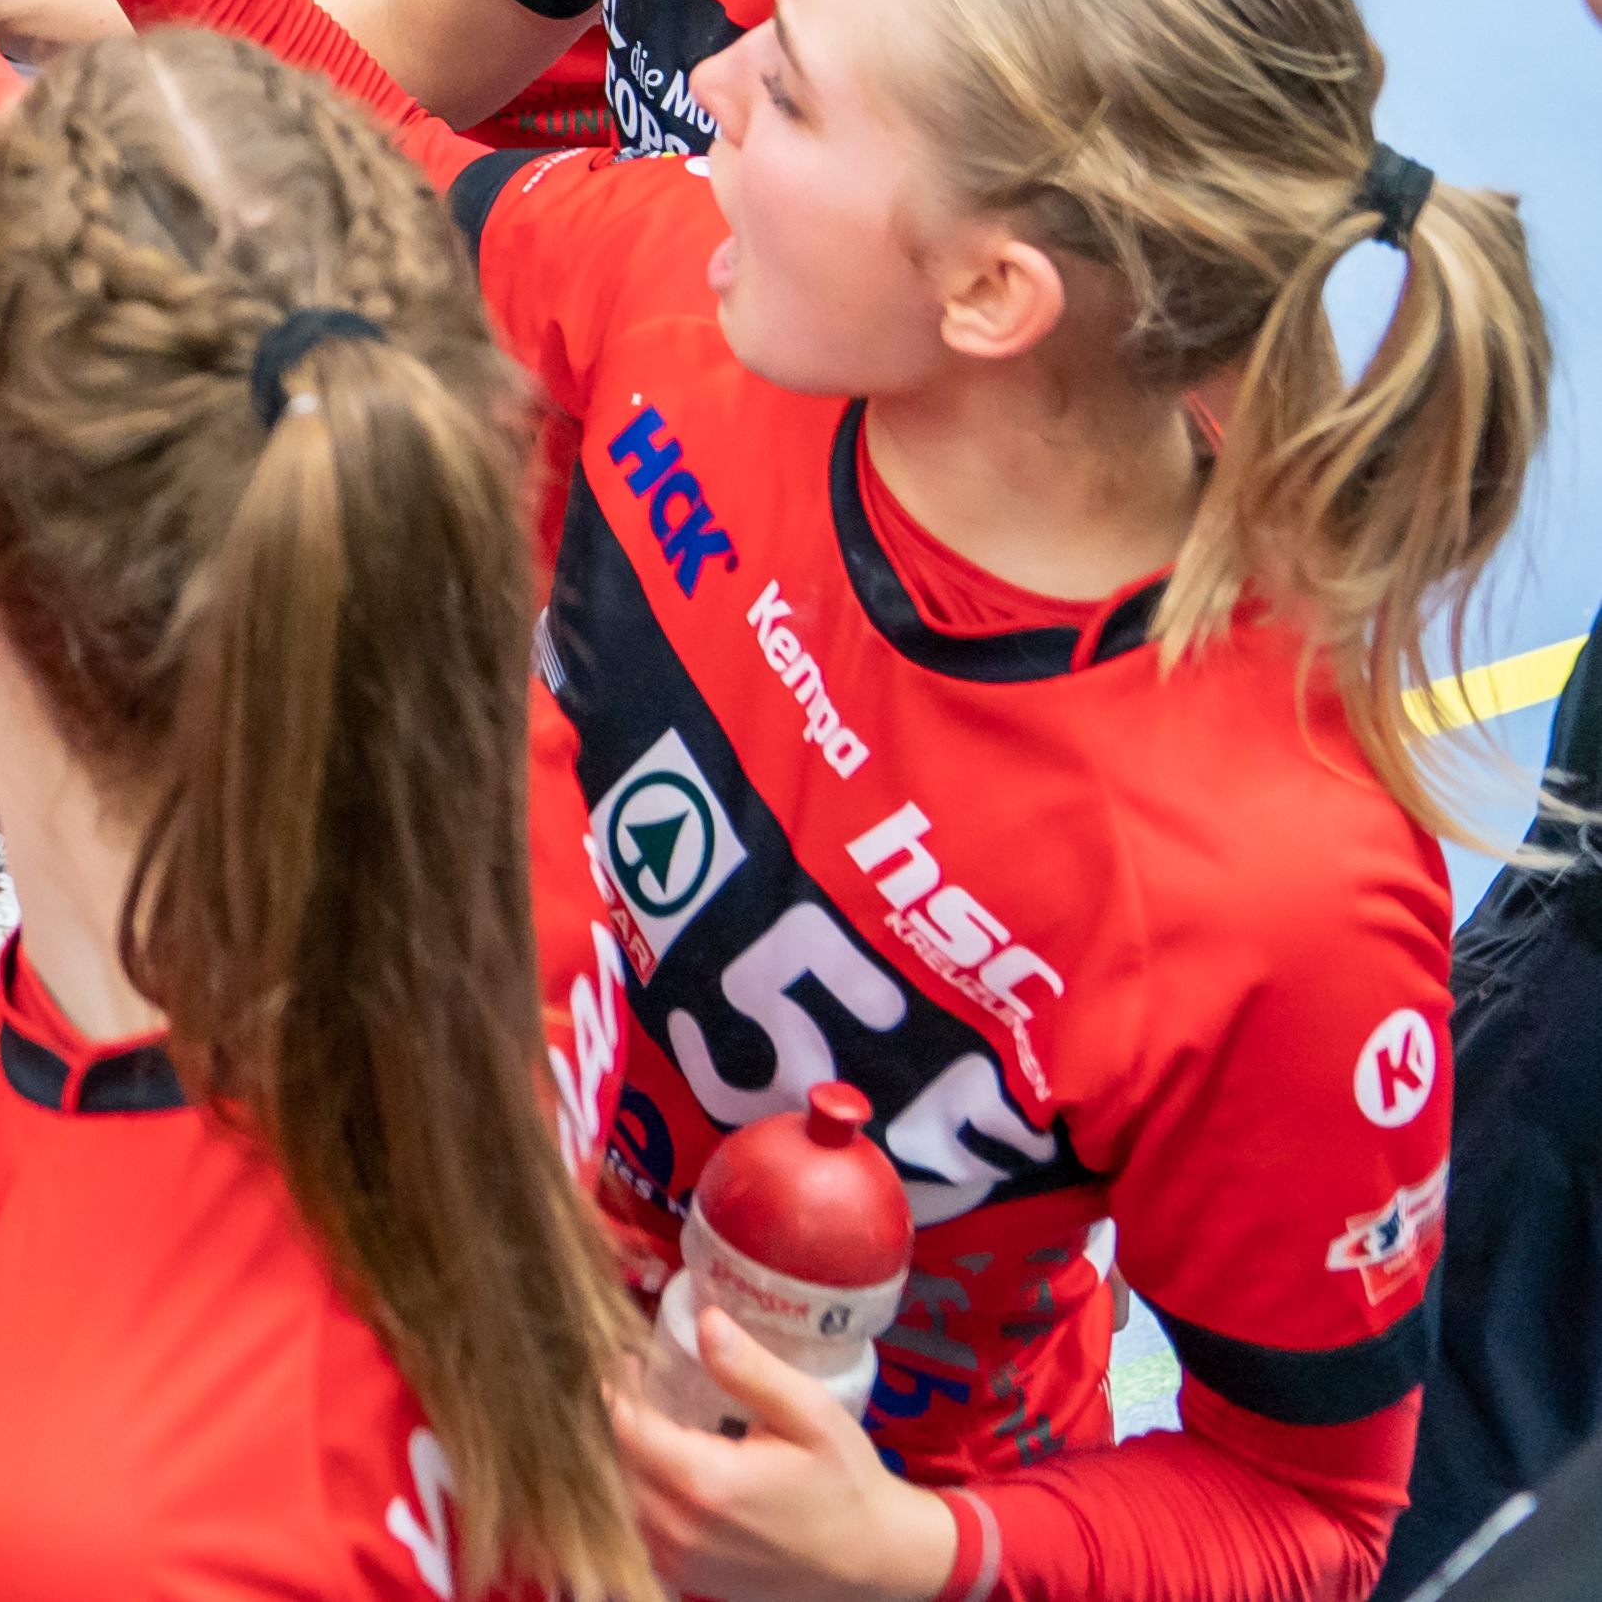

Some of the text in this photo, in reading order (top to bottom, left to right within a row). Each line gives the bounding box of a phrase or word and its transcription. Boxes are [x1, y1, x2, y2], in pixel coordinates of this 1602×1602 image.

[630, 40, 664, 100] die
[607, 404, 734, 600] HCK
[746, 578, 872, 780] Kempa
[843, 799, 1066, 1020] hsc
